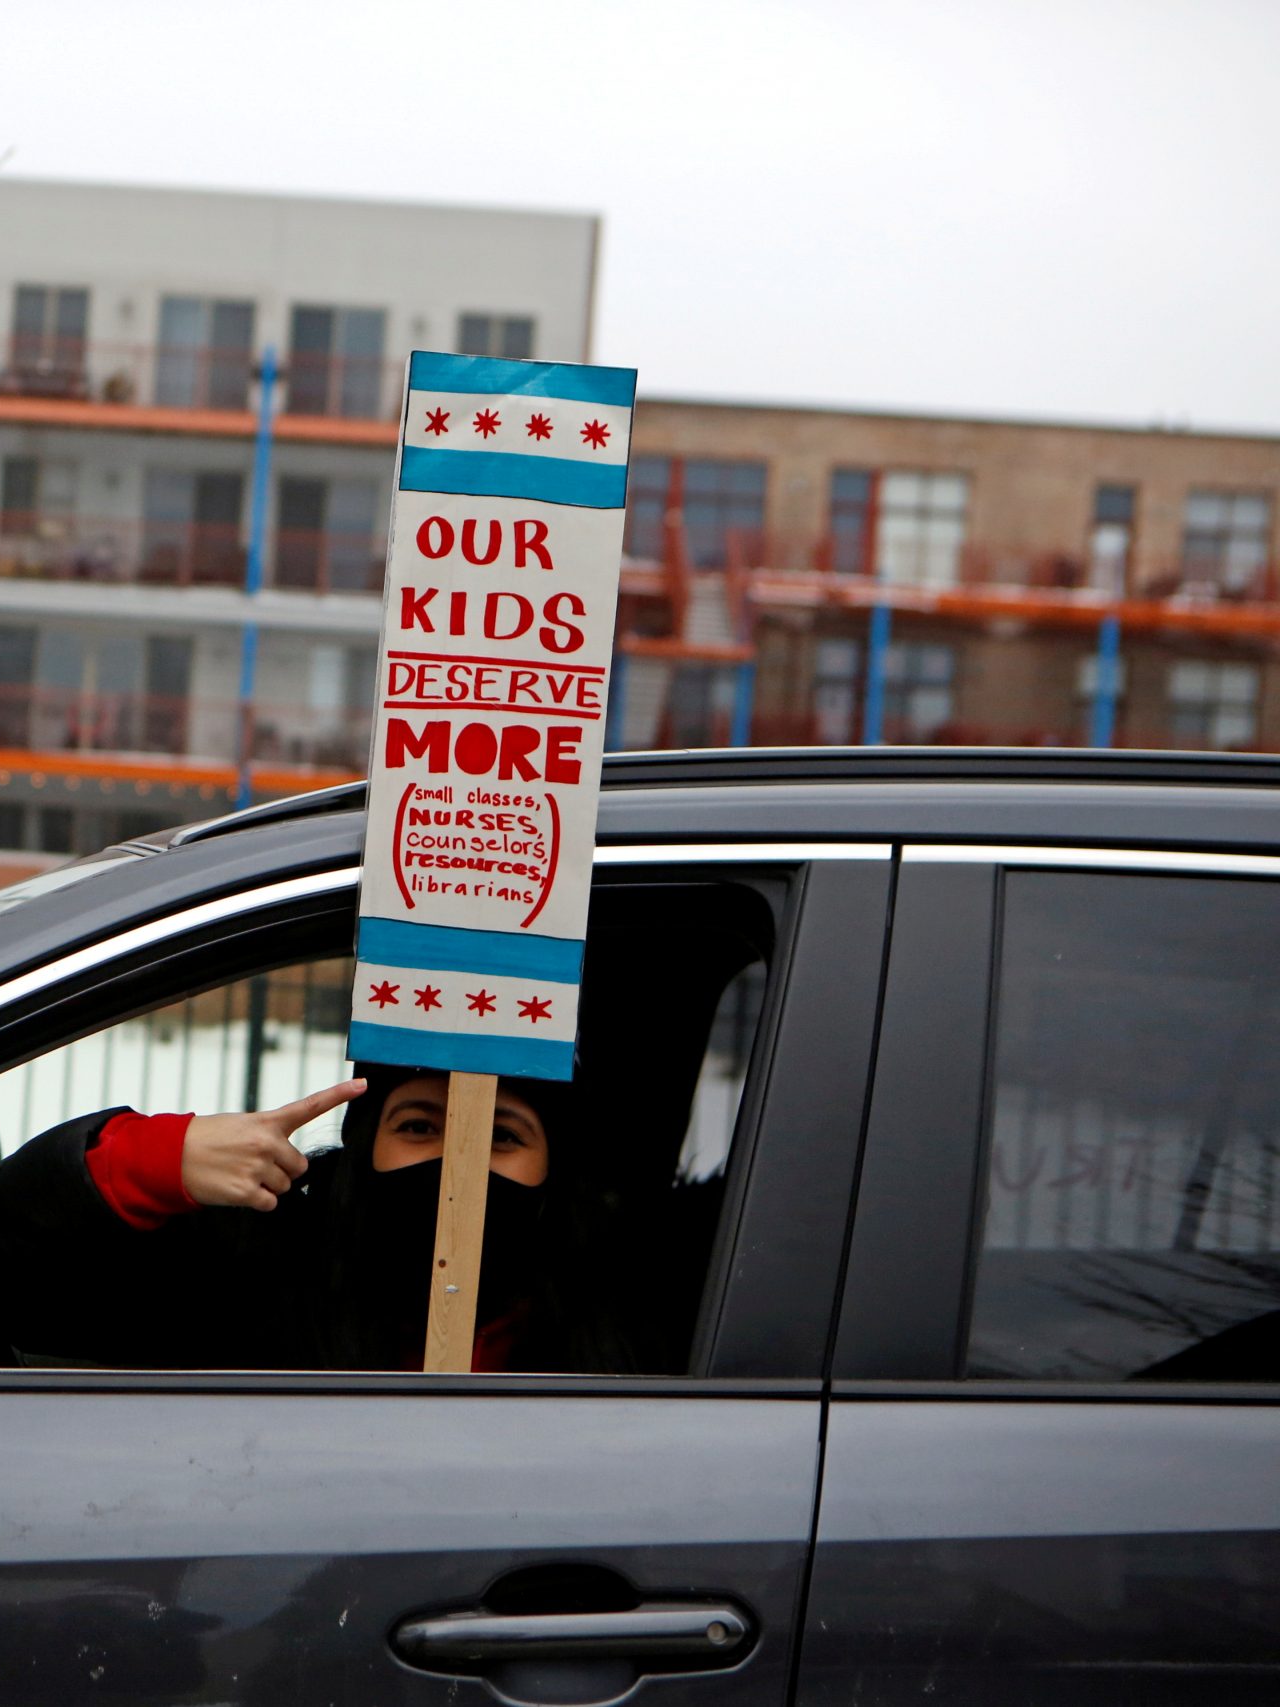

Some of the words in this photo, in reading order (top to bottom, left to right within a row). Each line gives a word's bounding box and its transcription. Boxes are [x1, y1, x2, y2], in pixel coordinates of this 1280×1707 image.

[416, 515, 554, 570] OUR
[400, 586, 587, 654] KIDS
[387, 662, 604, 709] DESERVE
[384, 717, 583, 785] MORE
[467, 787, 541, 812] classes,
[409, 807, 544, 840] NURSES,
[404, 850, 547, 889] resources,
[411, 873, 534, 904] librarians
